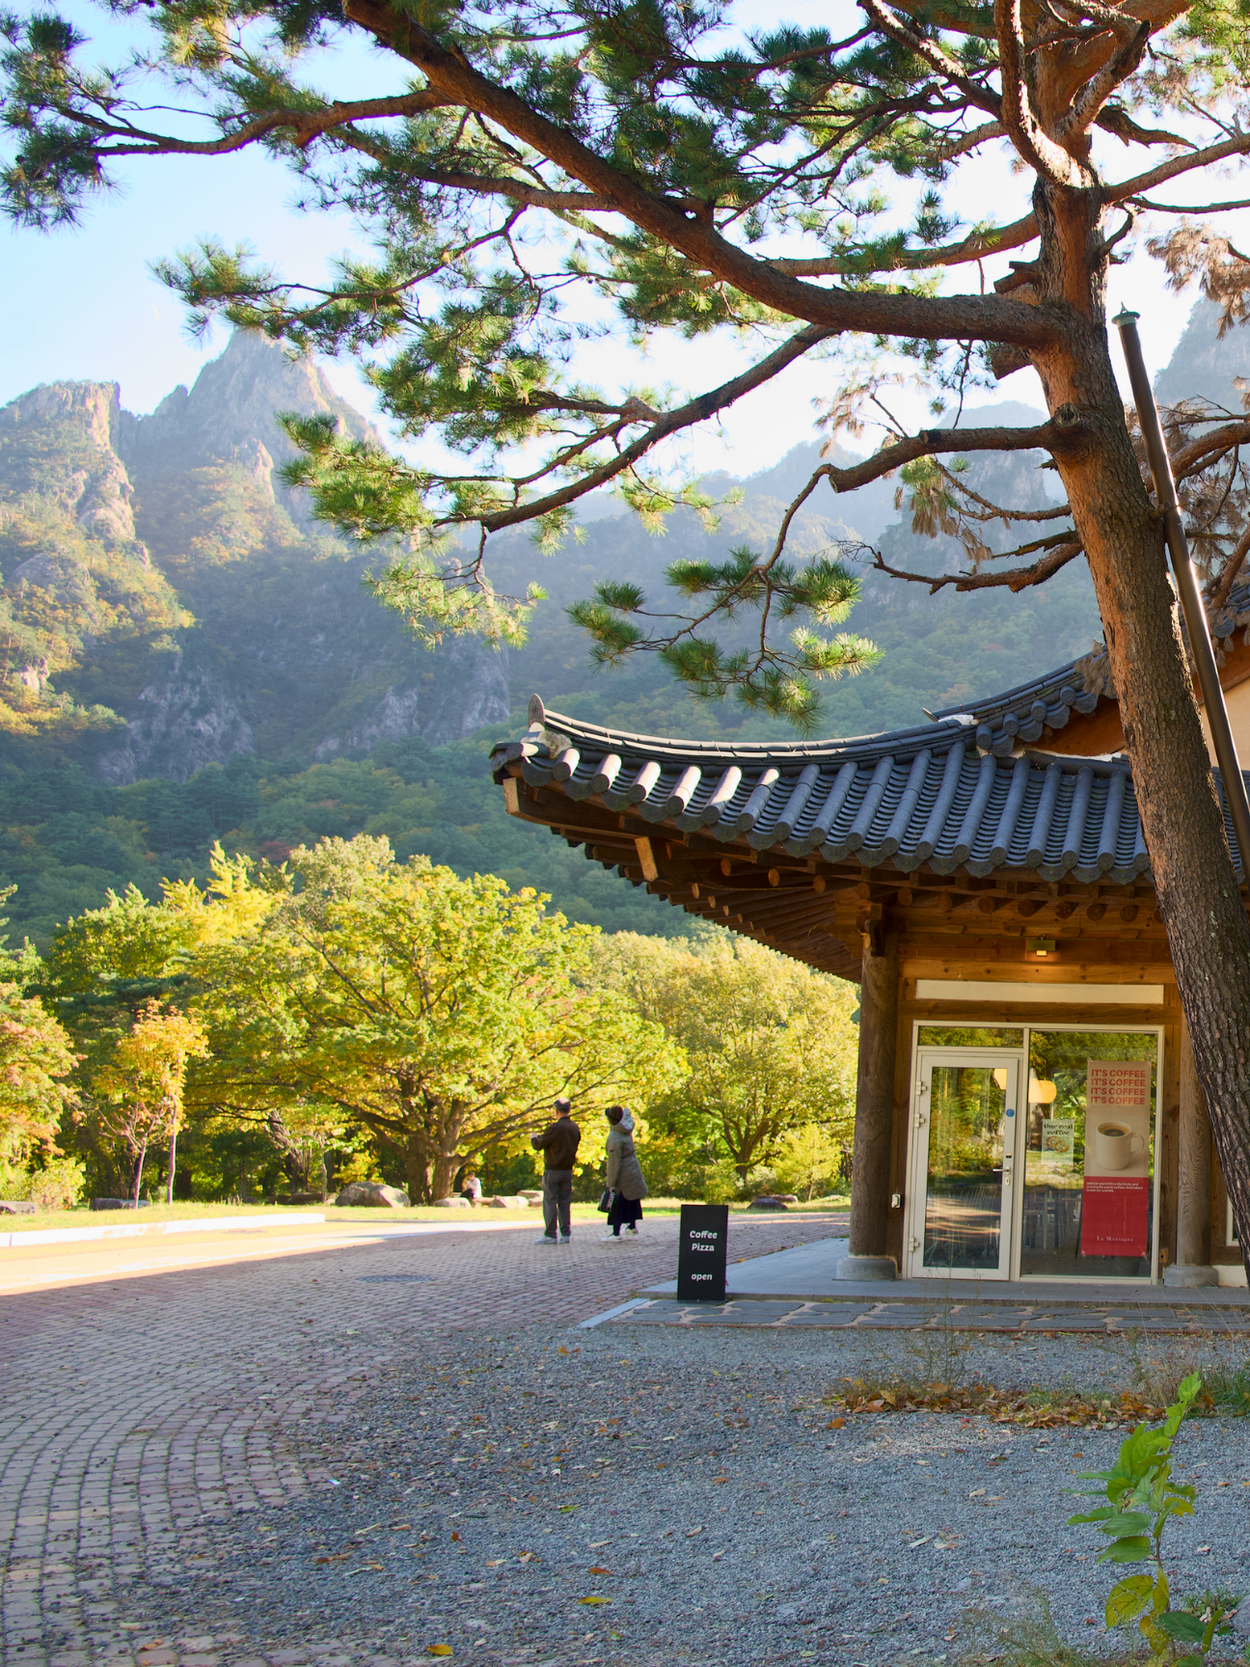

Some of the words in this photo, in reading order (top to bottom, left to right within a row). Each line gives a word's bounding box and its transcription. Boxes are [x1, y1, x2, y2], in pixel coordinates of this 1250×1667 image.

[1109, 1070, 1146, 1078] COFFEE
[1109, 1088, 1145, 1096] COFFEE
[1108, 1096, 1145, 1105] COFFEE
[690, 1230, 718, 1239] Coffee
[692, 1243, 714, 1251] Pizza
